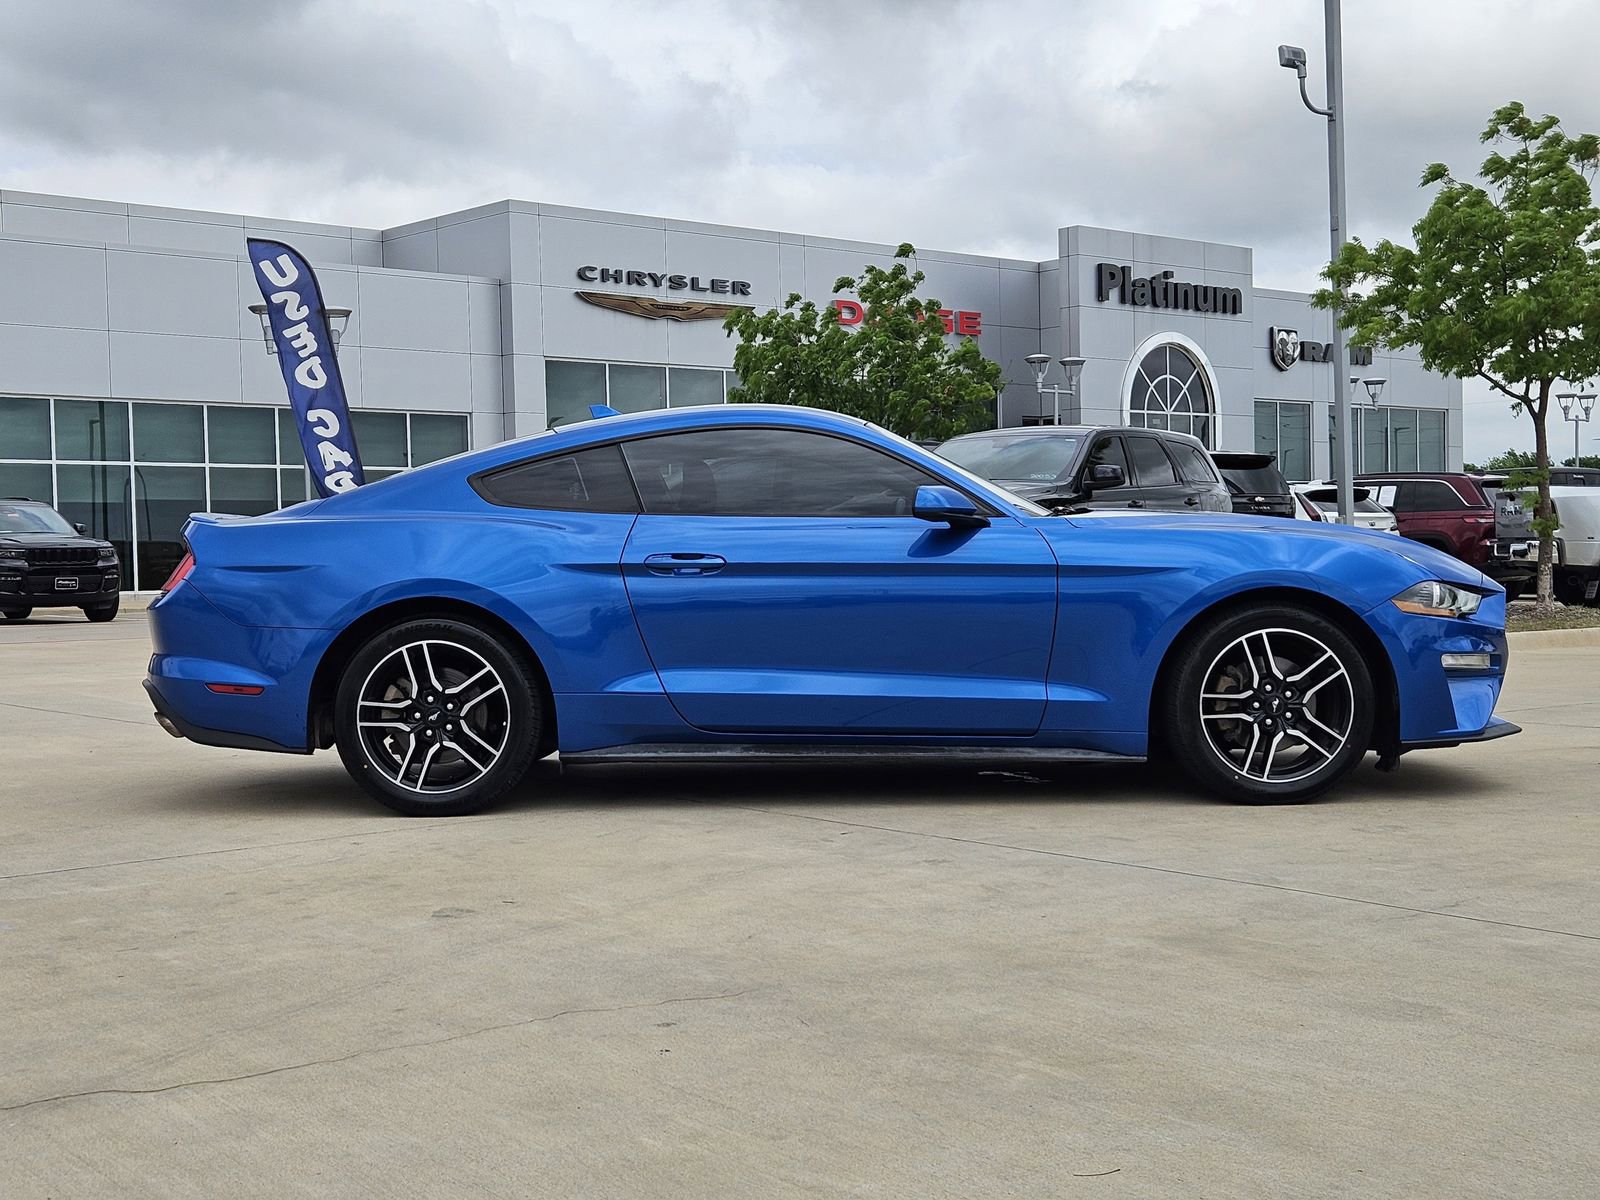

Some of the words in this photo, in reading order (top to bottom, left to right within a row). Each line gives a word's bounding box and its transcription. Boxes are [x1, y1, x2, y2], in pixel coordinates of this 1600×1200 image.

[576, 265, 752, 296] CHRYSLER
[1096, 262, 1243, 315] Platinum
[832, 299, 982, 336] DGE
